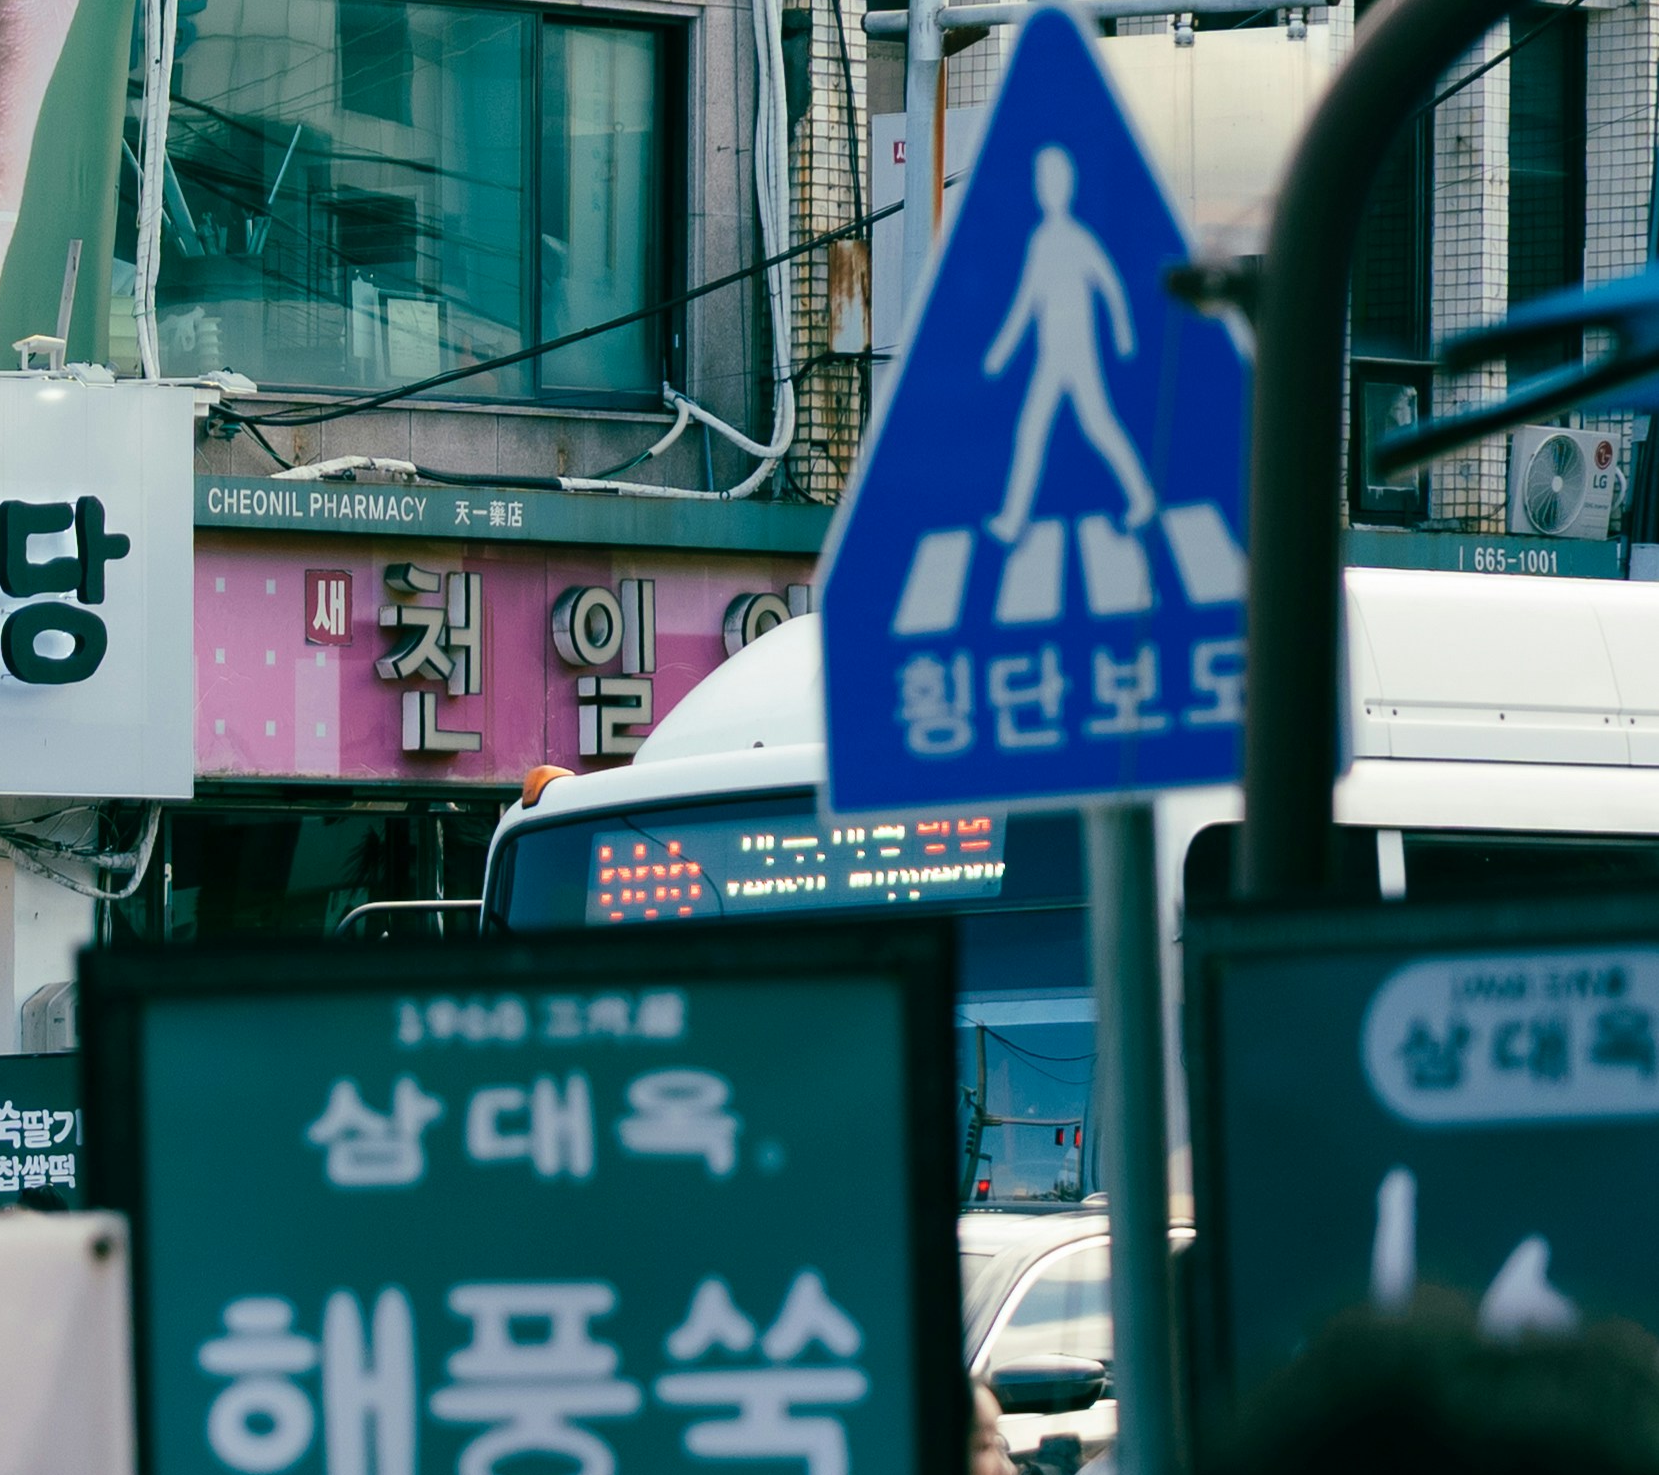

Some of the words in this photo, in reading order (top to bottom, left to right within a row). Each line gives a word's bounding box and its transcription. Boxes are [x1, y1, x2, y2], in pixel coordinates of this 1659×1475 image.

[1593, 474, 1607, 489] LG
[208, 487, 305, 520] CHEONIL
[308, 492, 427, 524] PHARMACY
[1475, 547, 1558, 574] 665-1001
[312, 578, 347, 636] 새
[895, 643, 1247, 760] 횡단보도
[306, 1068, 740, 1188] 삼대옥
